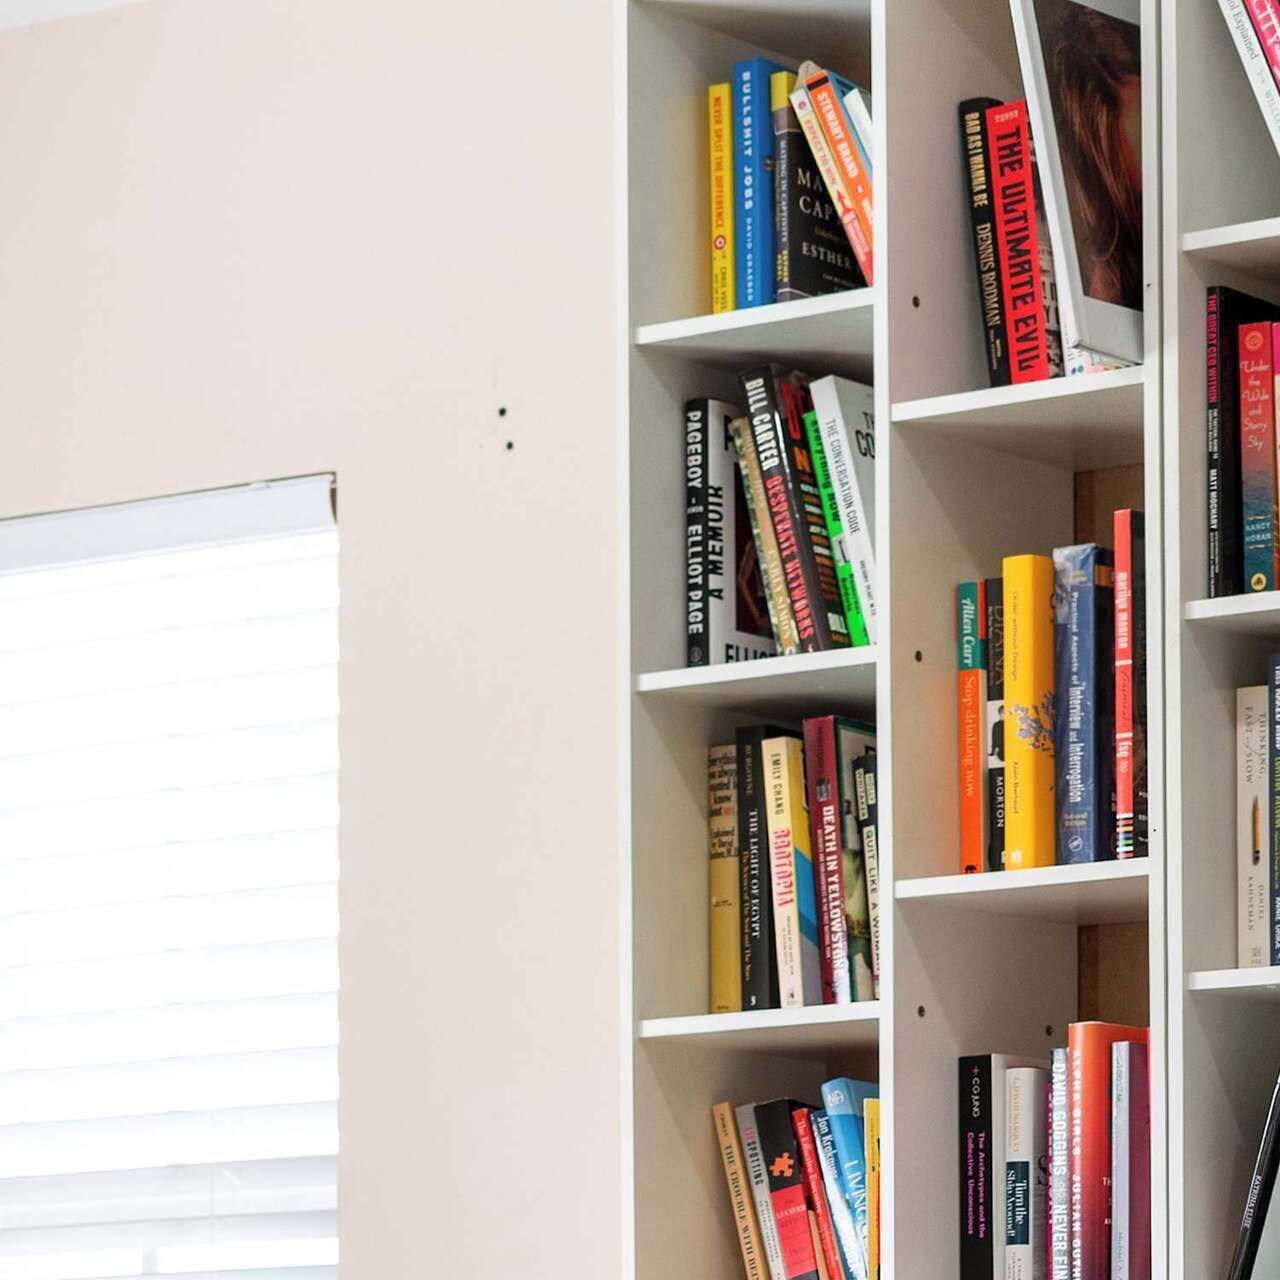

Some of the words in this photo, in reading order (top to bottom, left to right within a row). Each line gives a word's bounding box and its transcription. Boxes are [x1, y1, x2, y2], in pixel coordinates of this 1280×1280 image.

[741, 71, 753, 156] BULLSHIT
[817, 91, 845, 141] STEWART
[836, 143, 860, 179] BRAND
[714, 152, 724, 172] THE
[996, 126, 1024, 178] THE
[743, 165, 753, 210] JOBS
[975, 223, 994, 270] DENNIS
[1001, 180, 1035, 312] ULTIMATE
[977, 271, 1001, 326] RODMAN
[1012, 316, 1041, 372] EVIL
[744, 378, 766, 413] BILL
[687, 410, 702, 489] PAGEBOY
[752, 413, 779, 471] CARTER
[688, 525, 703, 589] ELLIOT
[765, 475, 798, 559] DESPERATE
[787, 560, 816, 640] NETWORKS
[688, 591, 703, 634] PAGE
[961, 598, 976, 634] Allen
[1070, 591, 1080, 632] Practical
[962, 635, 976, 667] Carr
[1070, 635, 1080, 672] Aspects
[961, 676, 977, 707] Stop
[1071, 675, 1081, 685] of
[1069, 686, 1085, 729] Interview
[963, 710, 977, 766] drinking
[1069, 730, 1080, 742] and
[965, 769, 975, 797] now
[1067, 743, 1085, 803] Interrogation
[748, 808, 759, 829] THE
[822, 805, 837, 851] DEATH
[749, 838, 759, 873] LIGHT
[825, 854, 838, 870] IN
[750, 879, 760, 893] OF
[750, 900, 761, 938] EGYPT
[826, 872, 845, 979] YELLOWSTONE
[1052, 1063, 1066, 1105] DAVID
[724, 1145, 736, 1166] THE
[966, 1132, 976, 1177] Collective
[978, 1132, 986, 1150] The
[1053, 1110, 1067, 1175] GOGGINS
[729, 1170, 746, 1222] TROUBLE
[977, 1152, 986, 1202] Archetypes
[967, 1179, 976, 1235] Unconscious
[978, 1204, 987, 1223] and
[1054, 1204, 1067, 1250] NEVER
[741, 1226, 752, 1253] WITH
[979, 1224, 987, 1239] the
